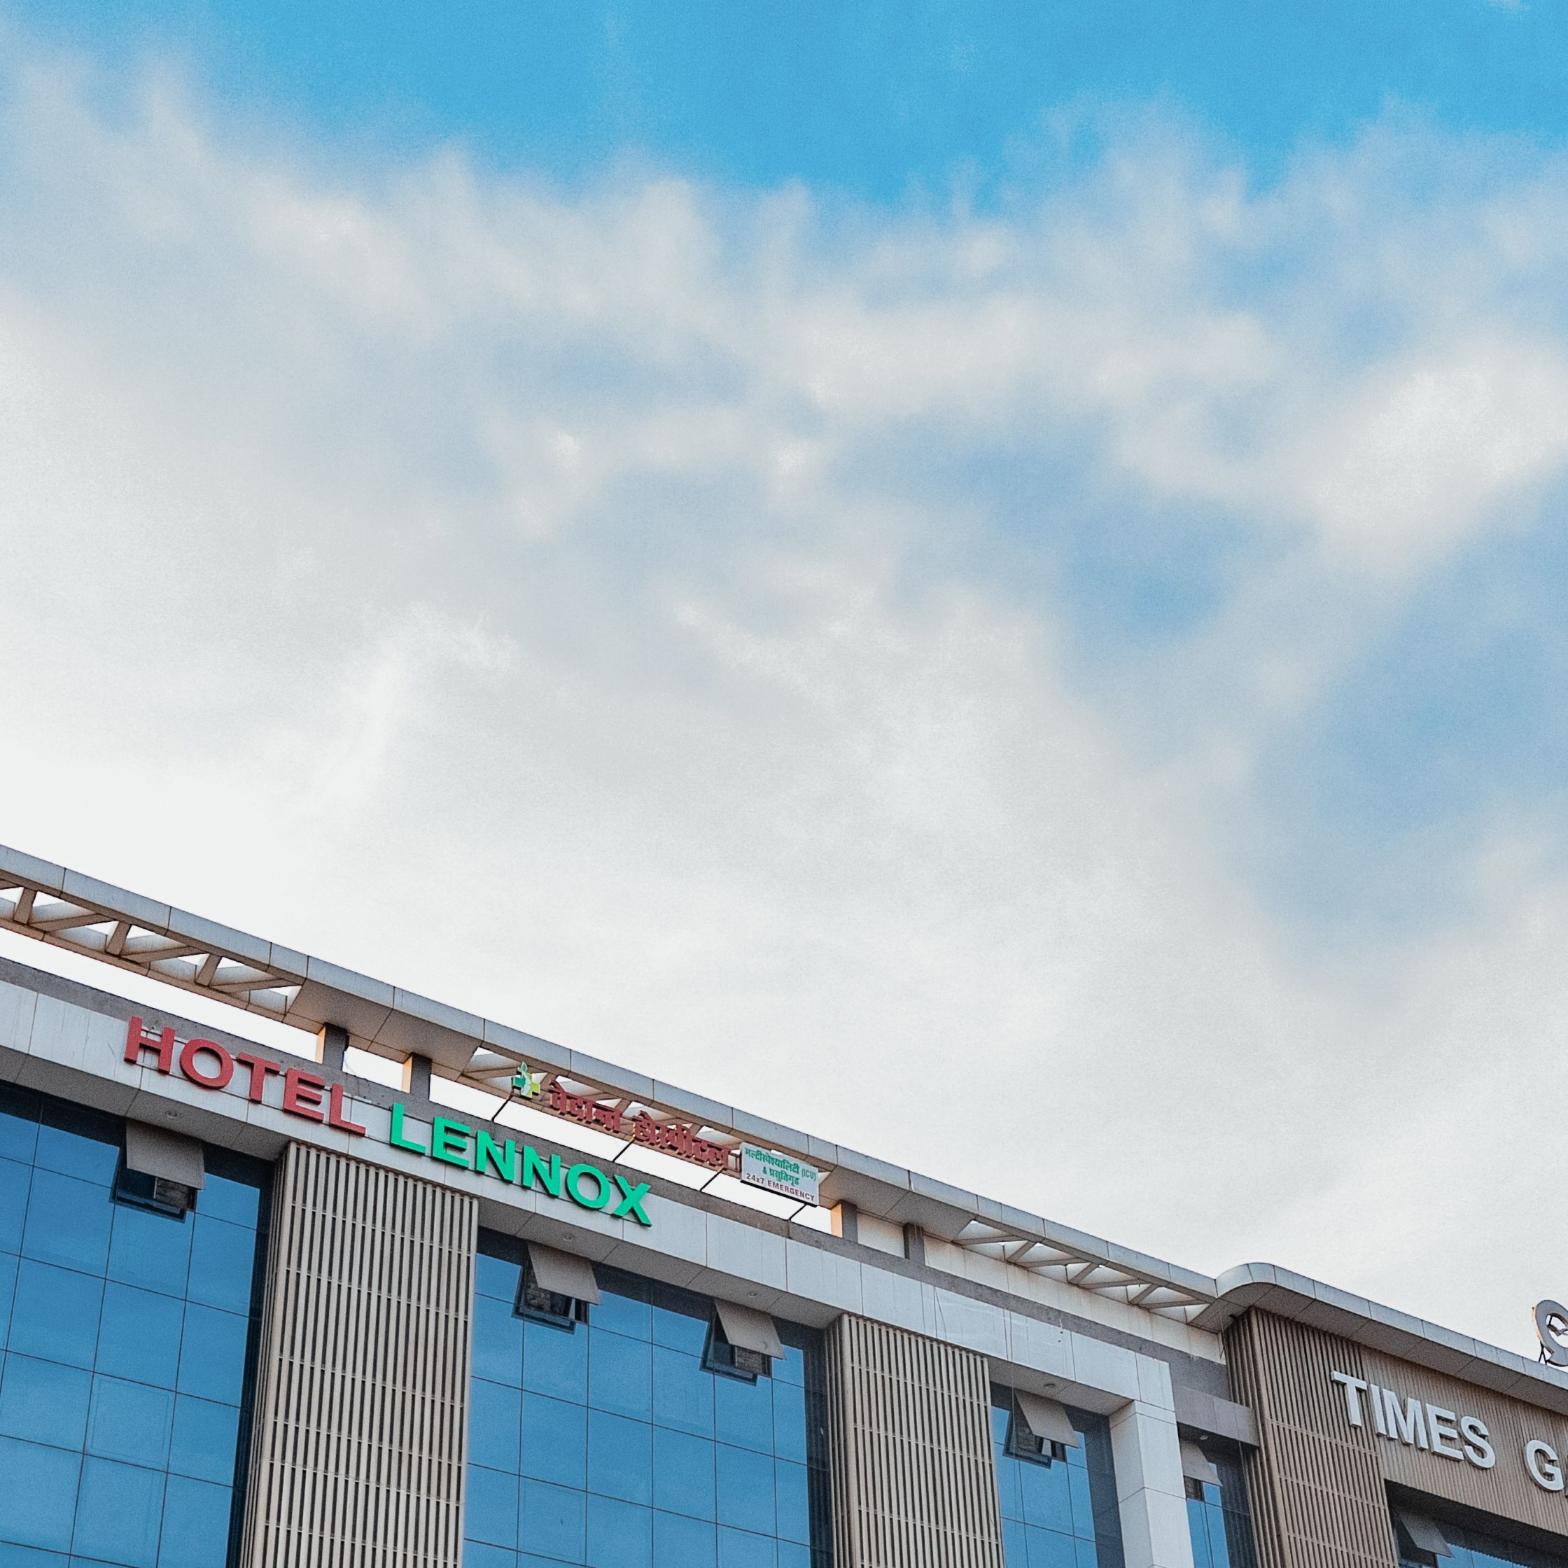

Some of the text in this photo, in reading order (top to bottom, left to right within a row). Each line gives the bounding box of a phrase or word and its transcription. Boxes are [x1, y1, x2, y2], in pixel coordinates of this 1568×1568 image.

[124, 1016, 653, 1227] HOTEL LENNOX
[766, 1179, 815, 1202] EMERGENCY
[1330, 1369, 1497, 1472] TIMES
